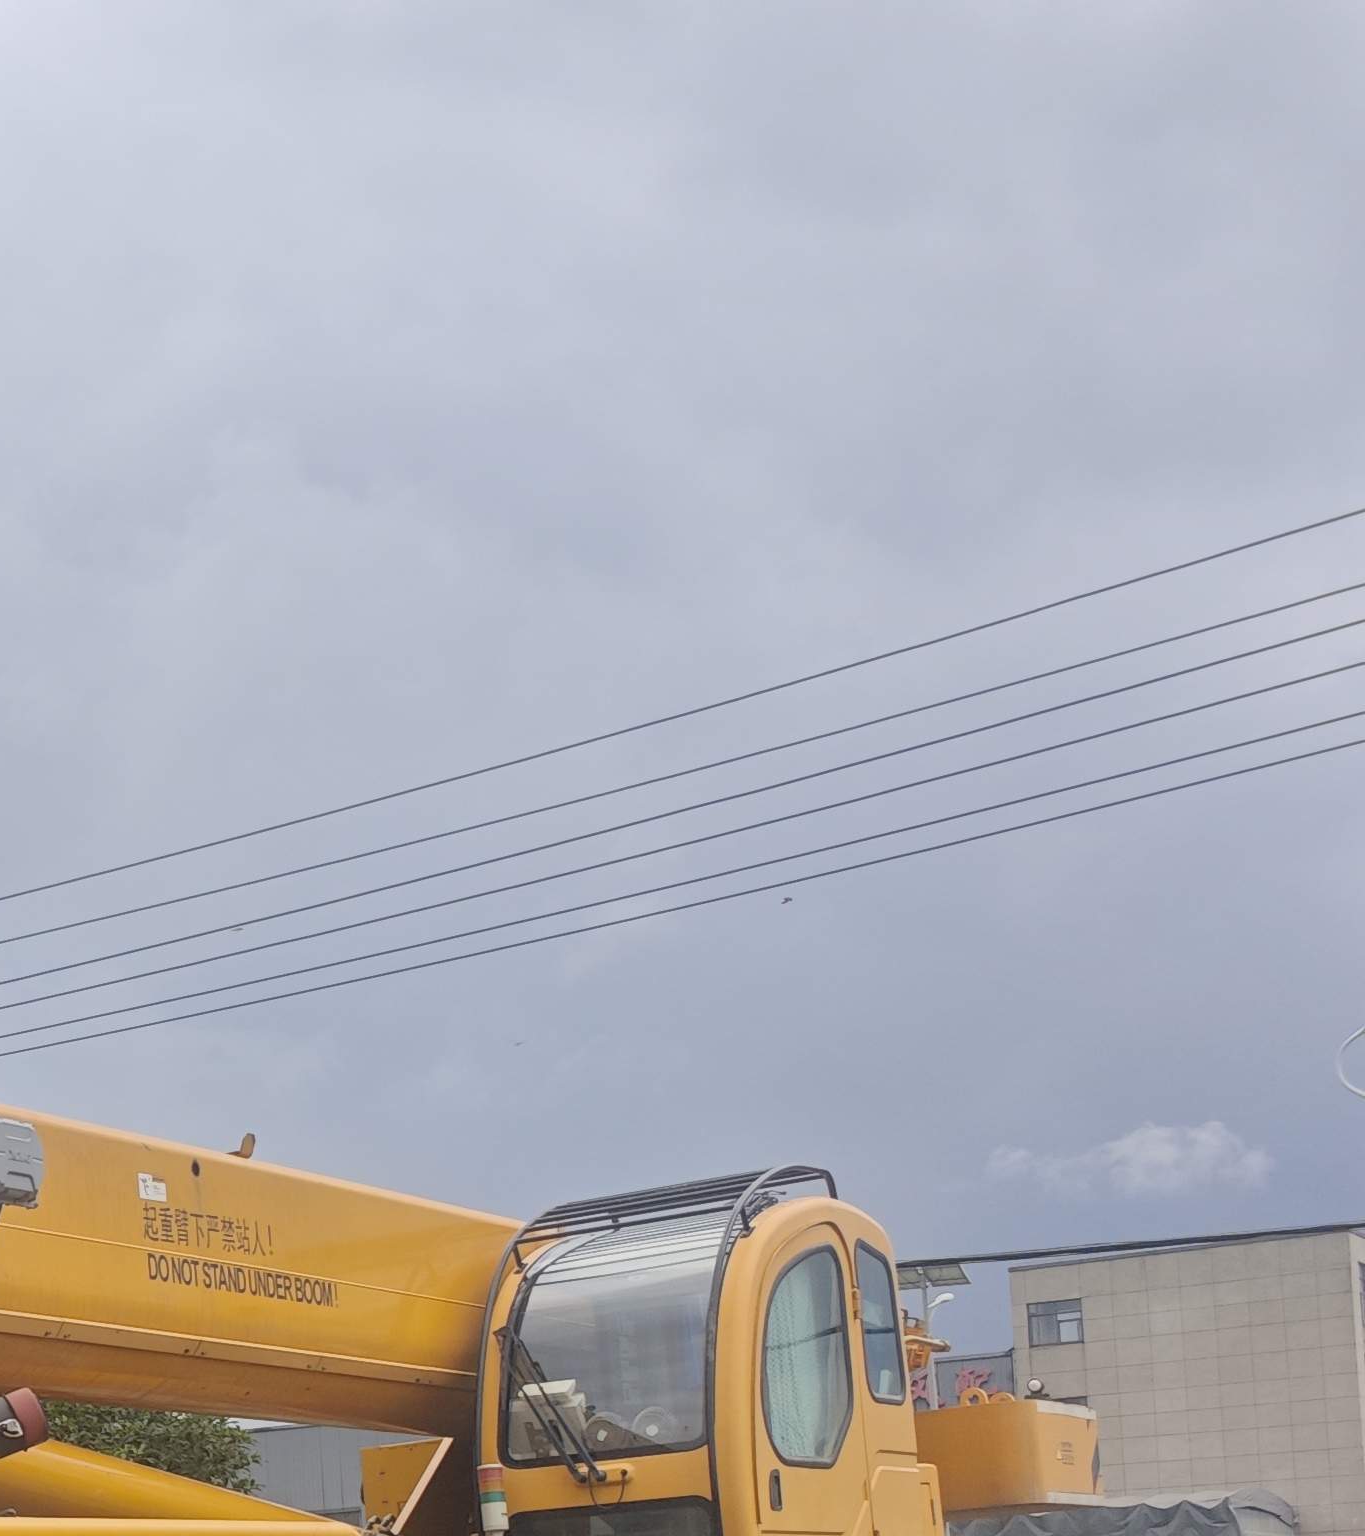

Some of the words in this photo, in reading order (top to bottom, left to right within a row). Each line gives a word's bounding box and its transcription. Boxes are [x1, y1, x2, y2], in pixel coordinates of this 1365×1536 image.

[147, 1253, 169, 1282] DO
[172, 1257, 199, 1287] NOT
[202, 1262, 247, 1293] STAND
[249, 1269, 293, 1301] UNDER
